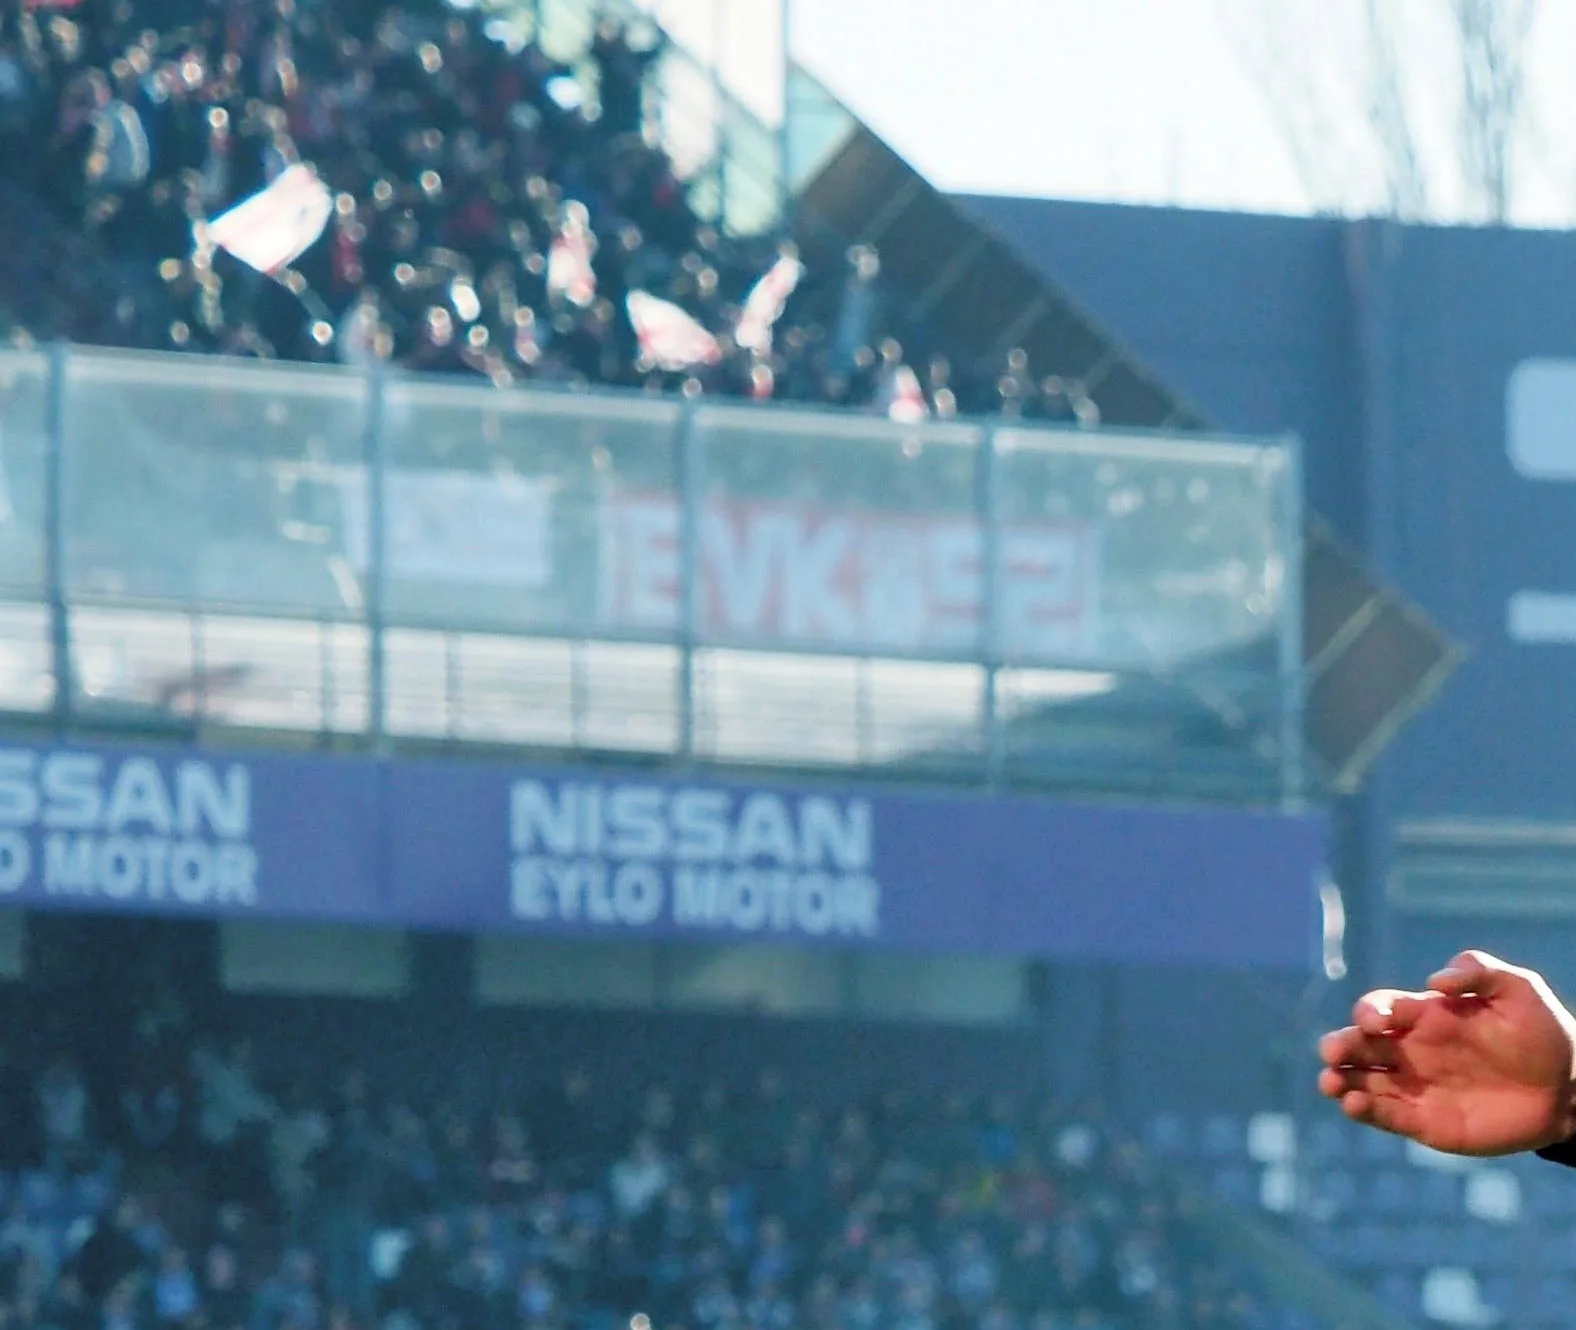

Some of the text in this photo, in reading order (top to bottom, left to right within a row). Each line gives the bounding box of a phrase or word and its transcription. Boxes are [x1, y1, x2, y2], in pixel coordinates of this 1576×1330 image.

[510, 778, 872, 869] NISSAN
[45, 834, 256, 906] MOTOR
[510, 856, 880, 937] EYLO MOTOR
